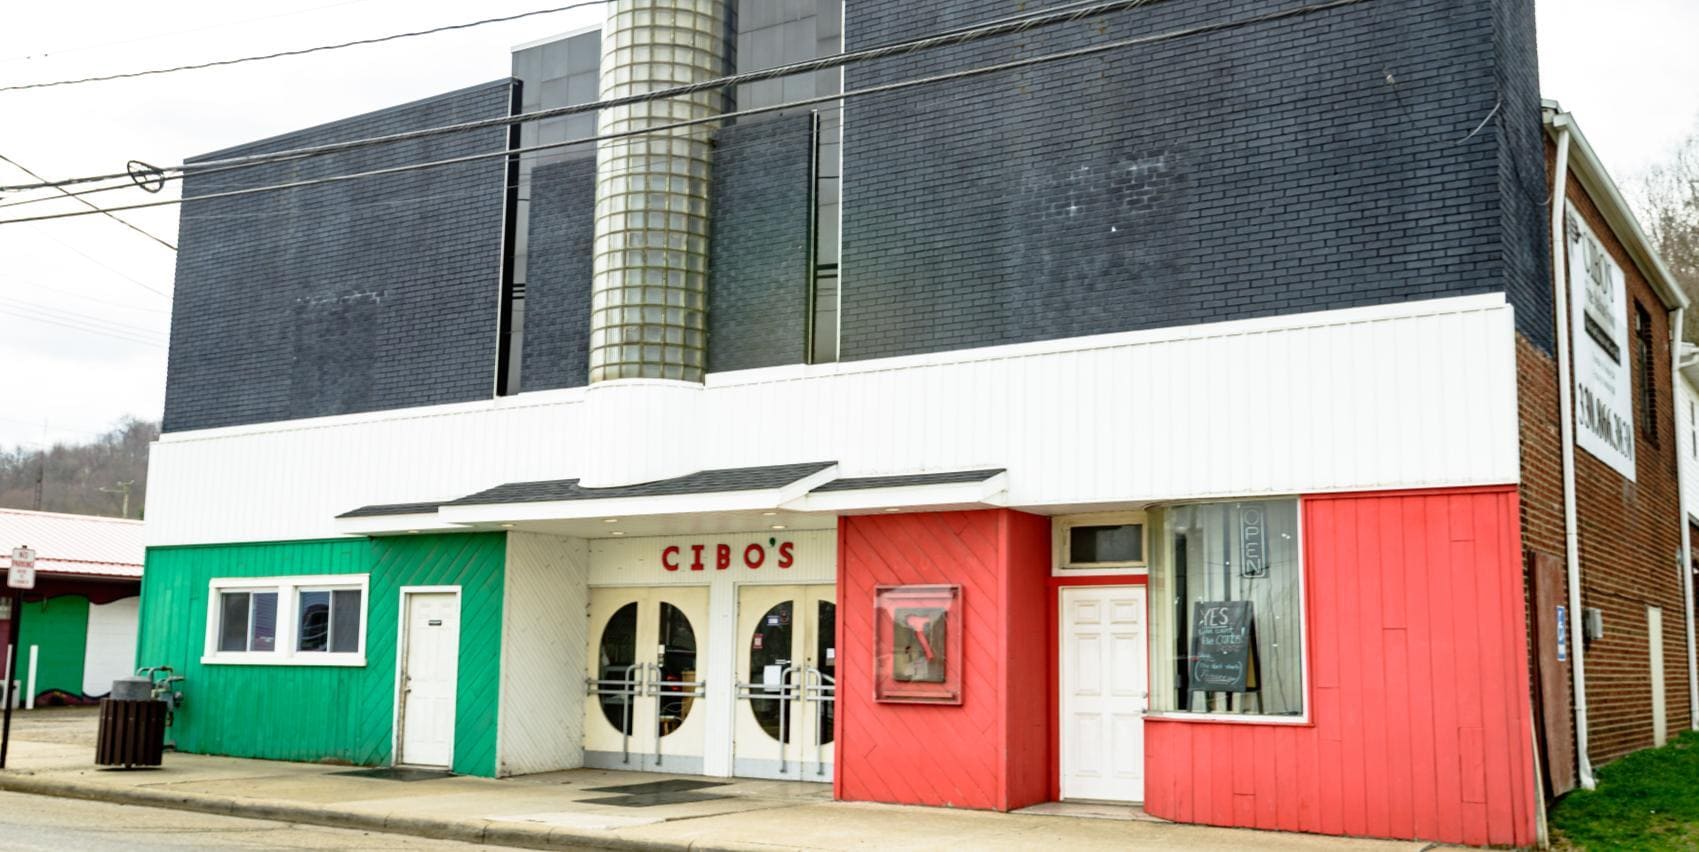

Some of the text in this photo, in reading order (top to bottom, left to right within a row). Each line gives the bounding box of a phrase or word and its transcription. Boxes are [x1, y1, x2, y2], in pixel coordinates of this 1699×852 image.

[661, 537, 794, 571] CIBO'S
[1244, 509, 1261, 574] OPEN
[1200, 607, 1229, 626] YES
